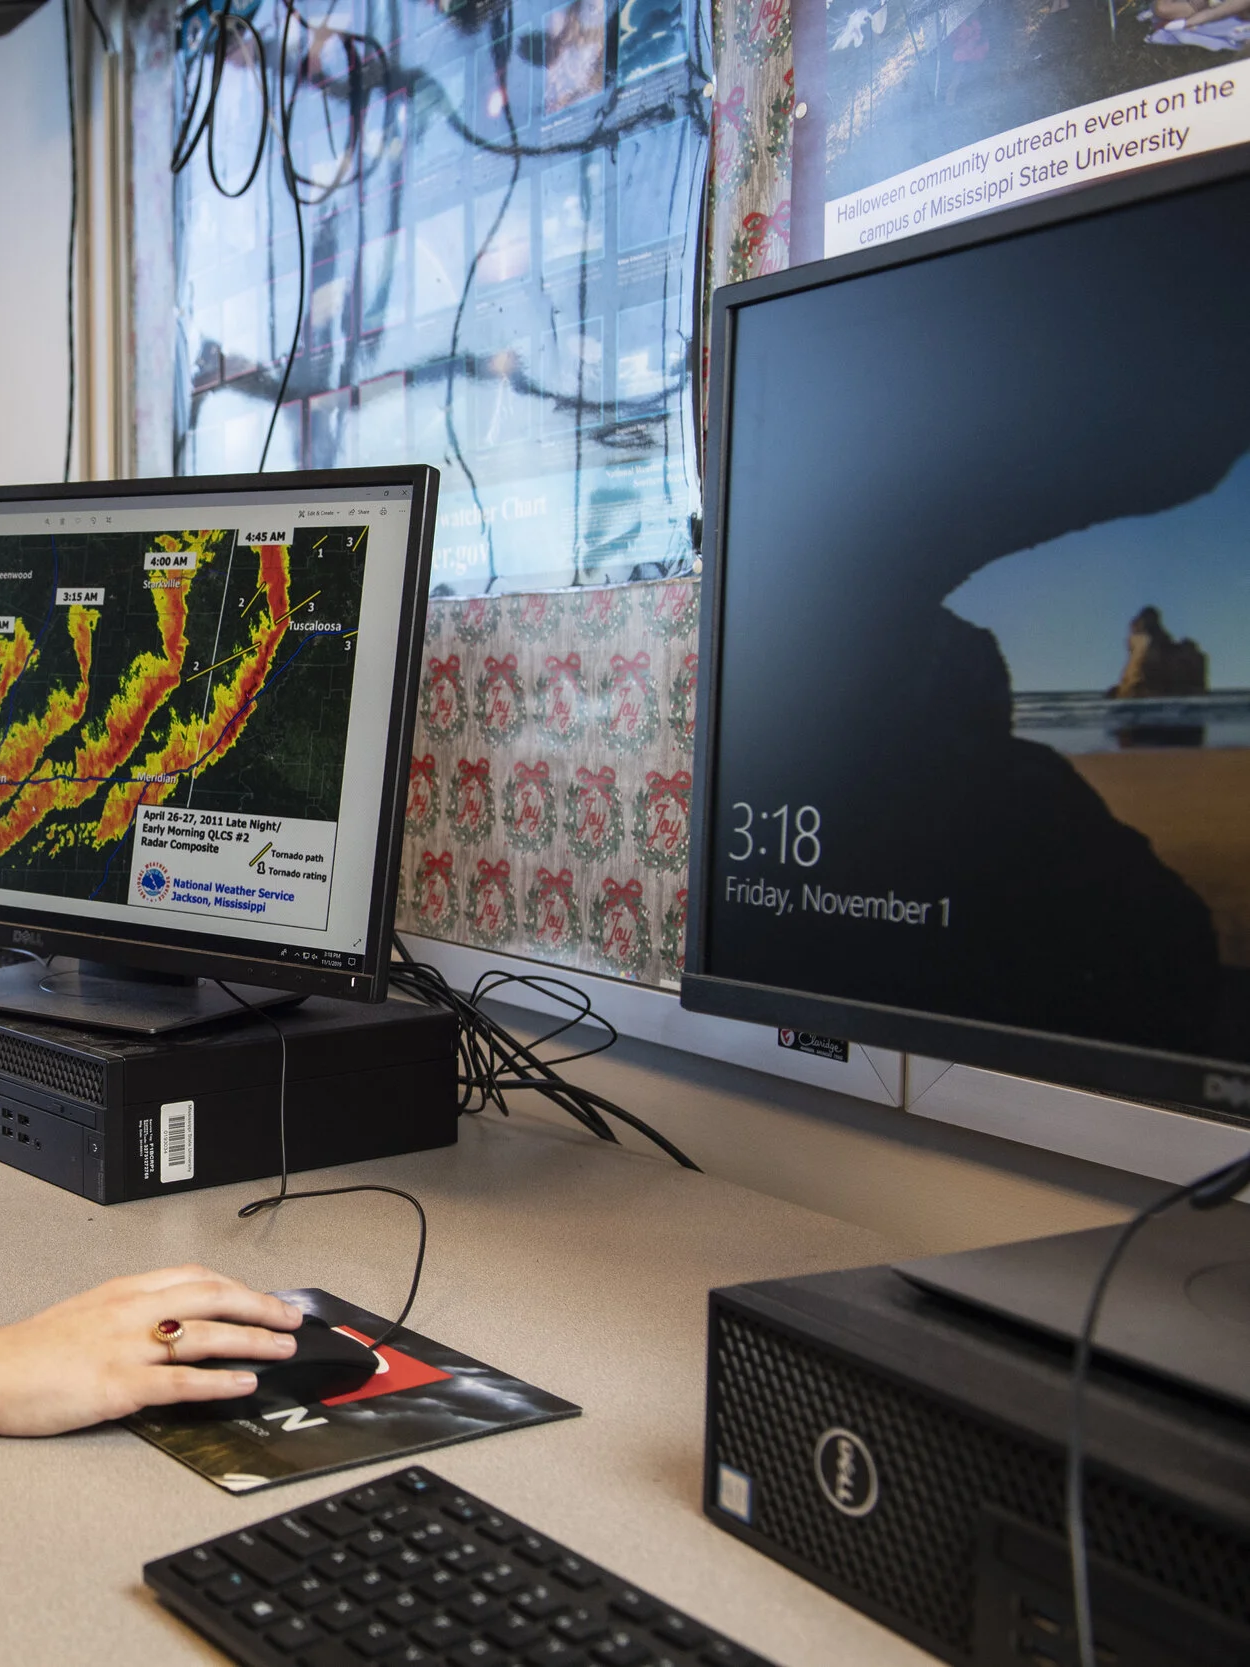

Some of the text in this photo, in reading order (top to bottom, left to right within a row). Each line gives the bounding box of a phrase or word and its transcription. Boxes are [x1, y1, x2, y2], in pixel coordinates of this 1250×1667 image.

[837, 77, 1236, 224] Halloween community outreach event on the
[859, 126, 1191, 245] campus of Mississippi State University
[501, 497, 548, 521] Chart
[245, 531, 286, 543] 4:45 AM
[346, 537, 353, 547] 3
[150, 555, 188, 567] 4:00 AM
[317, 549, 324, 558] 1
[142, 578, 181, 589] Starkville
[62, 592, 98, 602] 3:15 AM
[238, 597, 245, 608] 2
[307, 601, 315, 612] 3
[288, 620, 342, 632] Tuscaloosa
[344, 640, 351, 651] 3
[193, 661, 199, 671] 2
[429, 685, 454, 724] Joy
[486, 686, 511, 727] Joy
[546, 687, 572, 728] Joy
[609, 688, 639, 731] Joy
[136, 772, 177, 784] Meridian
[457, 786, 483, 826] Joy
[514, 791, 541, 832] Joy
[143, 810, 282, 833] April 26-27, 2011 Late Night/
[577, 798, 606, 838] Joy
[646, 804, 682, 849] Joy
[142, 824, 250, 843] Early Morning QLCS #2
[728, 801, 821, 868] 3:18
[141, 837, 219, 854] Radar Composite
[271, 850, 324, 863] Tornado path
[268, 867, 301, 878] Tornado
[302, 870, 327, 882] rating
[173, 878, 295, 902] National Weather Service
[420, 880, 445, 918] Joy
[725, 875, 950, 928] Friday, November 1
[171, 891, 266, 914] Jackson, Mississippi
[475, 890, 500, 928] Joy
[537, 900, 565, 942] Joy
[604, 912, 633, 955] Joy
[798, 1031, 843, 1053] Claridge
